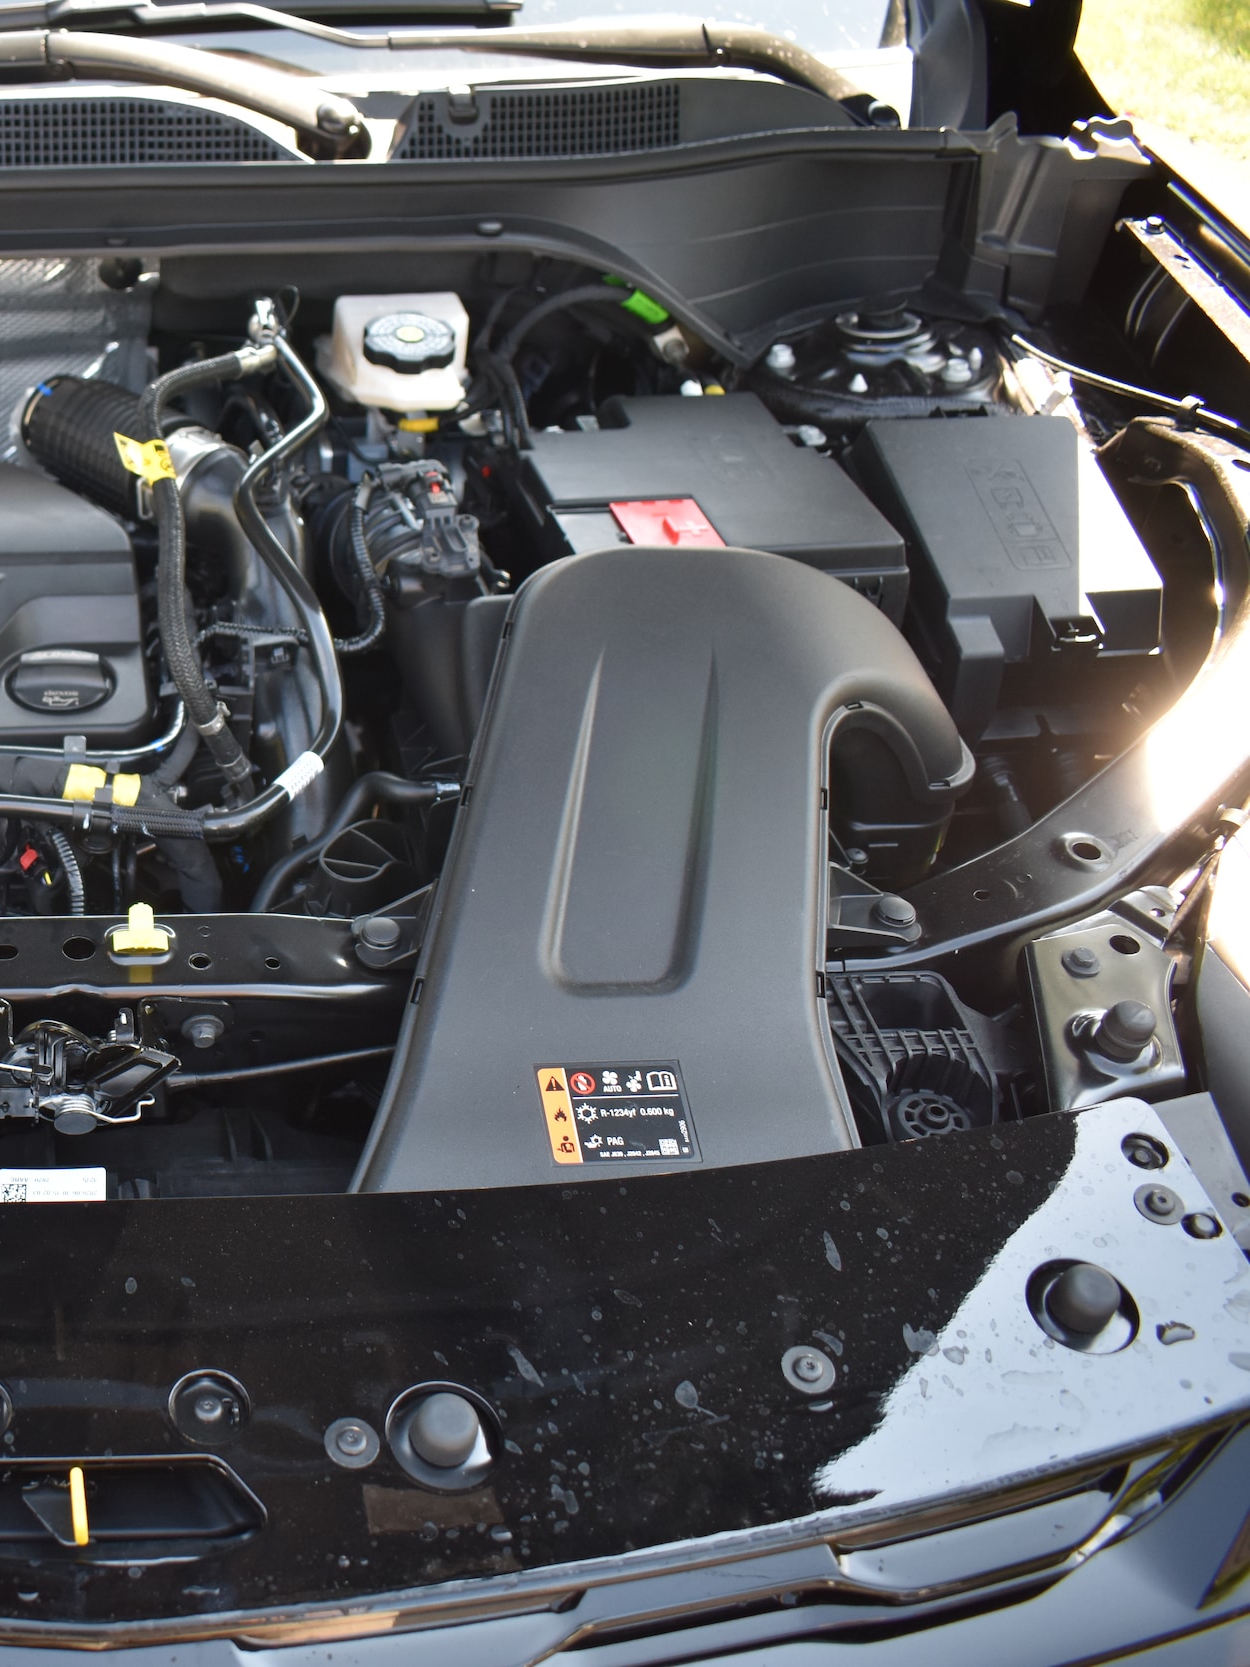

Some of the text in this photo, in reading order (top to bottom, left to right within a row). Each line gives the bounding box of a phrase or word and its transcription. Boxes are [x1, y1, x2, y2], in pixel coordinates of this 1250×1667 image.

[603, 1085, 623, 1093] AUTO
[600, 1107, 675, 1118] R-1234yf 0.600 kg
[606, 1136, 625, 1146] PAG
